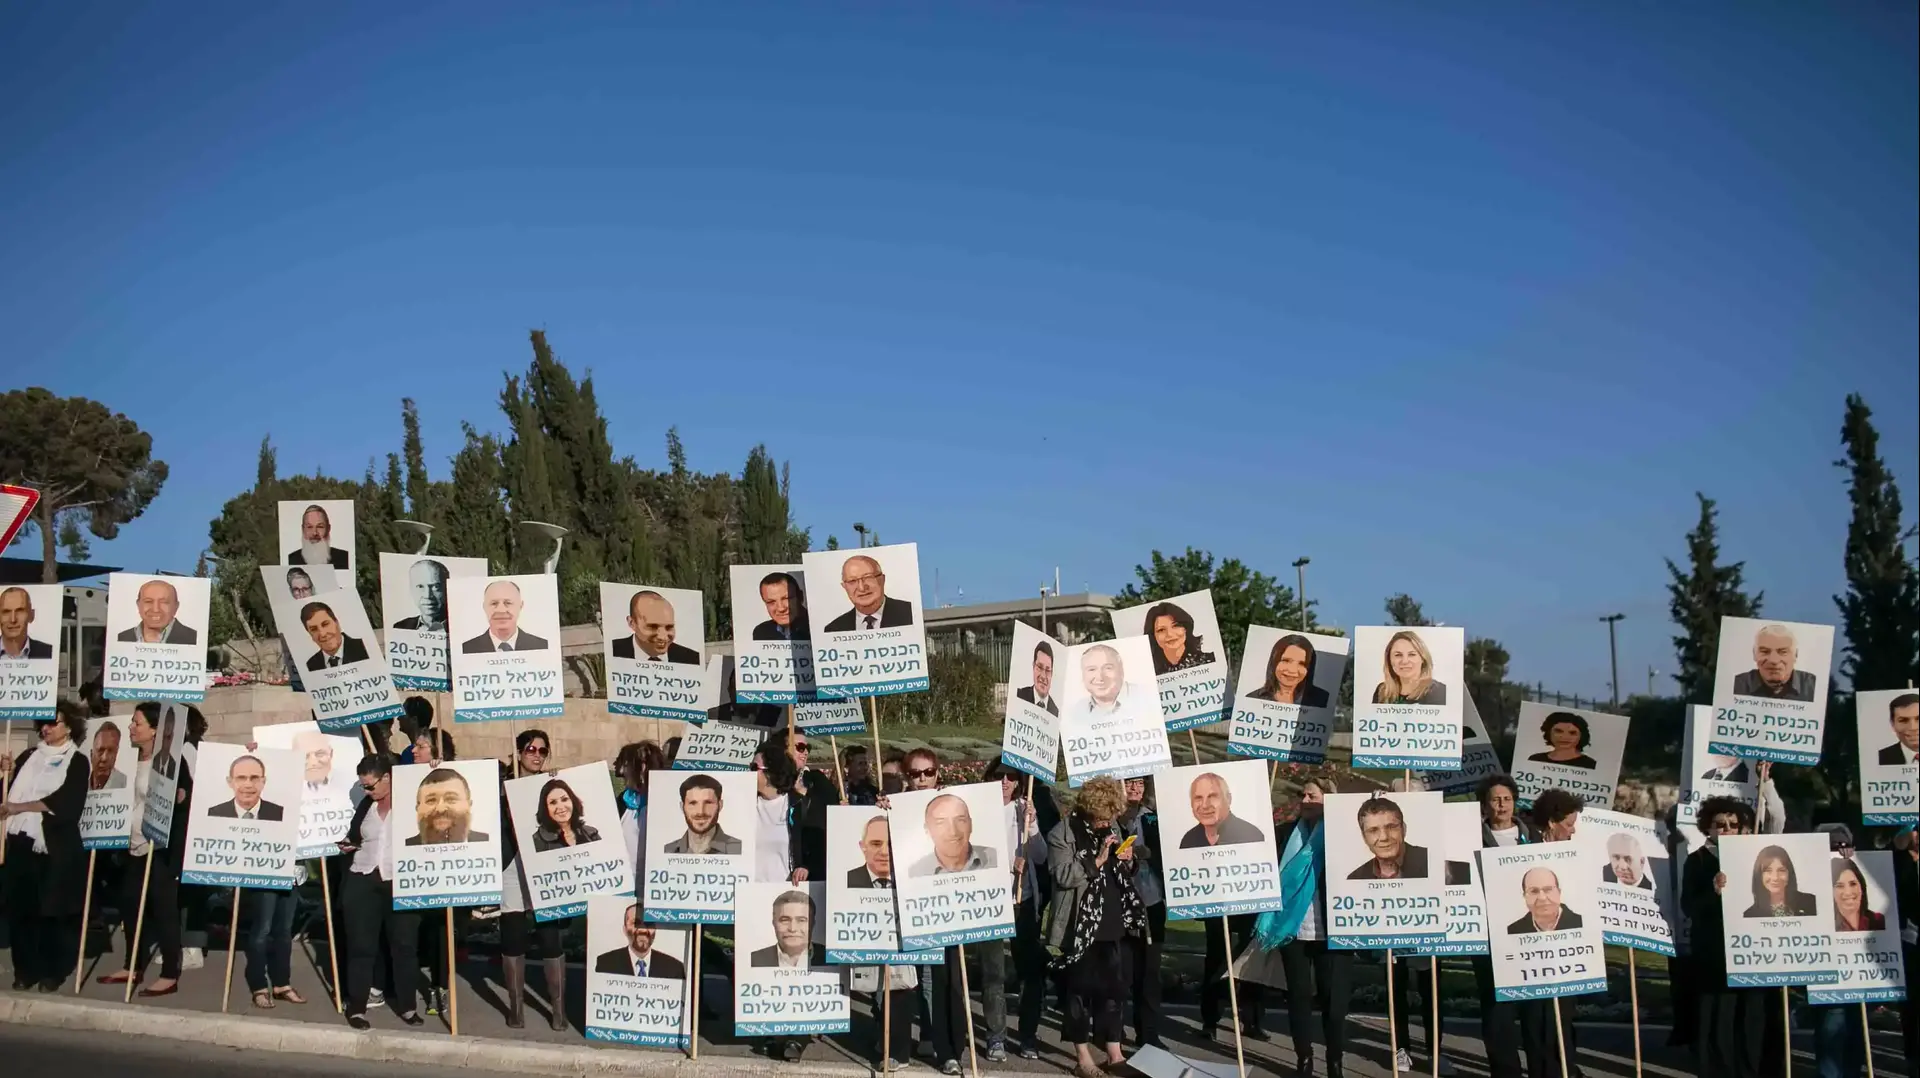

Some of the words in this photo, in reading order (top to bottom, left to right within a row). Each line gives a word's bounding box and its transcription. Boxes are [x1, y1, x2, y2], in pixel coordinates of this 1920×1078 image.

[833, 634, 874, 642] טרכטנברג
[818, 649, 858, 662] ה-20
[864, 644, 920, 659] הכנסת
[152, 660, 201, 670] הכנסת
[392, 657, 430, 670] שלום
[740, 656, 778, 668] ה-20
[869, 660, 920, 675] תעשה
[111, 670, 149, 682] שלום
[506, 671, 556, 683] ישראל
[743, 671, 783, 683] שלום
[821, 664, 863, 678] שלום
[154, 674, 199, 684] תעשה
[343, 676, 386, 692] ישראל
[459, 674, 500, 688] חזקה
[612, 672, 649, 685] חזקה
[656, 675, 700, 688] ישראל
[310, 686, 342, 700] חזקה
[464, 688, 505, 701] שלום
[512, 686, 553, 698] עושה
[617, 686, 653, 699] שלום
[878, 684, 904, 692] עושות
[353, 690, 388, 706] עושה
[659, 691, 698, 704] עושה
[1734, 697, 1759, 706] אריאל
[320, 699, 348, 712] שלום
[1717, 708, 1756, 724] ה-20
[1762, 715, 1818, 730] הכנסת
[1359, 719, 1397, 732] ה-20
[1403, 722, 1457, 734] הכנסת
[1718, 725, 1759, 738] שלום
[688, 733, 725, 744] חזקה
[1235, 726, 1274, 739] שלום
[1765, 731, 1815, 745] תעשה
[1068, 737, 1105, 752] ה-20
[1360, 735, 1401, 748] שלום
[1407, 739, 1455, 750] תעשה
[688, 745, 725, 755] שלום
[1072, 751, 1111, 767] שלום
[1558, 778, 1611, 793] הכנסת
[1868, 781, 1910, 793] חזקה
[1873, 794, 1915, 806] שלום
[96, 804, 129, 815] ישראל
[96, 819, 125, 830] עושה
[1581, 815, 1620, 827] הממשלה
[194, 838, 235, 851] חזקה
[242, 838, 291, 853] ישראל
[196, 852, 238, 865] שלום
[1202, 851, 1215, 860] ילין
[1498, 855, 1534, 866] הבטחון
[244, 857, 286, 869] עושה
[398, 860, 435, 873] ה-20
[441, 858, 496, 870] הכנסת
[574, 860, 624, 878] ישראל
[1170, 867, 1210, 881] ה-20
[1216, 862, 1272, 878] הכנסת
[400, 875, 439, 888] שלום
[446, 874, 495, 886] תעשה
[532, 870, 570, 886] חזקה
[650, 870, 687, 884] ה-20
[952, 875, 976, 884] מרדכי
[582, 875, 623, 893] עושה
[1172, 883, 1215, 898] שלום
[1222, 879, 1273, 894] תעשה
[540, 884, 576, 900] שלום
[651, 887, 690, 900] שלום
[955, 888, 1005, 904] ישראל
[1624, 892, 1648, 901] בנימין
[906, 895, 949, 911] חזקה
[1333, 896, 1374, 910] ה-20
[1381, 897, 1440, 909] הכנסת
[1598, 901, 1628, 912] מדיני
[961, 905, 1003, 921] עושה
[1632, 906, 1661, 918] הסכם
[834, 912, 878, 926] חזקה
[912, 911, 954, 927] שלום
[1335, 913, 1379, 927] שלום
[1386, 914, 1438, 926] תעשה
[1625, 920, 1638, 928] זה
[838, 927, 882, 941] שלום
[1519, 935, 1542, 945] יעלון
[1546, 933, 1567, 942] משה
[1731, 935, 1772, 948] ה-20
[1778, 935, 1831, 947] הכנסת
[1520, 950, 1554, 960] מדיני
[1559, 945, 1594, 957] הסכם
[1734, 952, 1776, 965] שלום
[1783, 952, 1831, 964] תעשה
[1521, 964, 1586, 980] בטחון
[1859, 968, 1899, 980] תעשה
[741, 984, 782, 996] ה-20
[788, 982, 846, 996] הכנסת
[593, 993, 630, 1007] חזקה
[792, 1000, 843, 1013] תעשה
[743, 1000, 786, 1014] שלום
[596, 1008, 634, 1022] שלום
[774, 1024, 797, 1032] שלום
